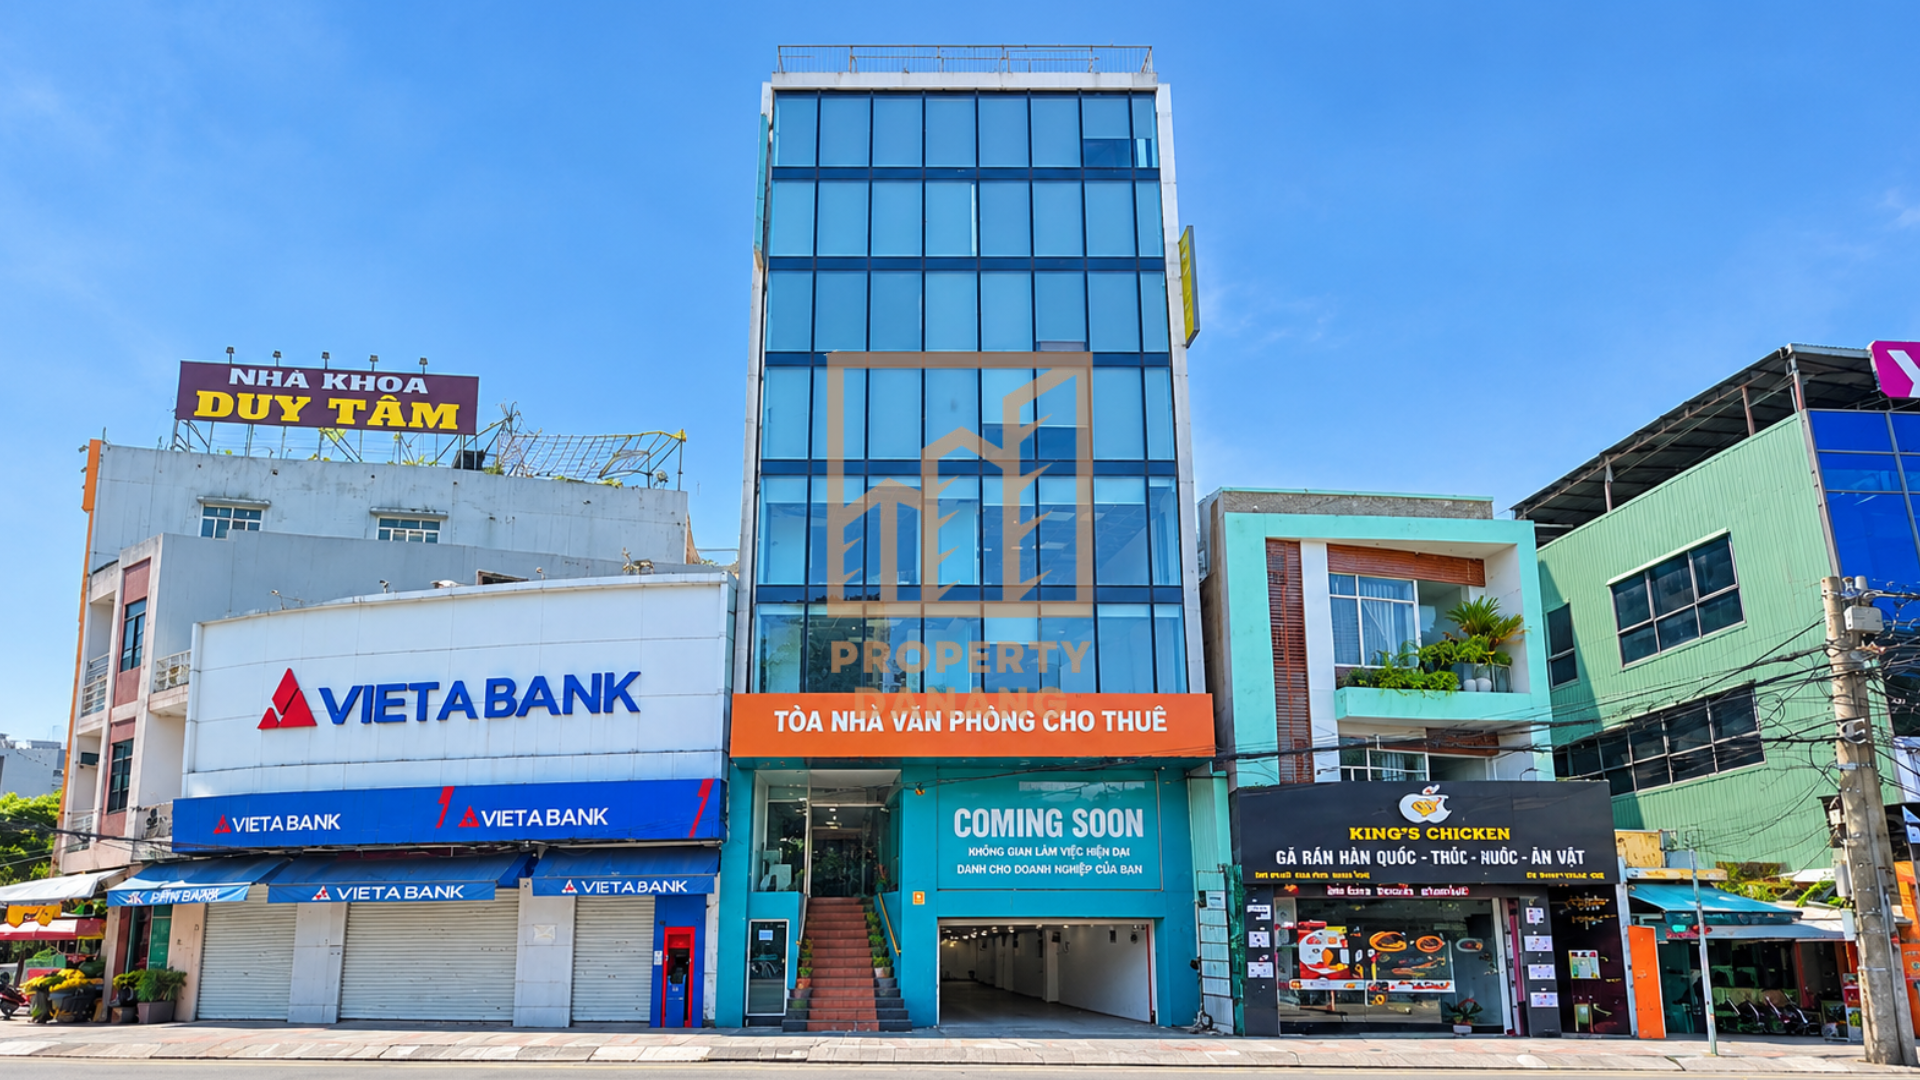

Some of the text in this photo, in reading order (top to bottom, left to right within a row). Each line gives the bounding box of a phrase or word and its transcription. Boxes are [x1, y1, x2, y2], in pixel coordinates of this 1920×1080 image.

[228, 368, 428, 394] NHÀ KHOA
[193, 390, 460, 430] DUY TÂM
[774, 704, 1168, 732] TÒA NHÀ VĂN PHÒNG CHO THUÊ
[954, 808, 1144, 838] COMING SOON
[1426, 827, 1511, 841] CHICKEN
[1302, 847, 1334, 865] RÁN
[1339, 847, 1371, 865] HÀN
[957, 864, 987, 875] DANH
[989, 864, 1011, 875] CHO
[1014, 864, 1051, 875] DOANH
